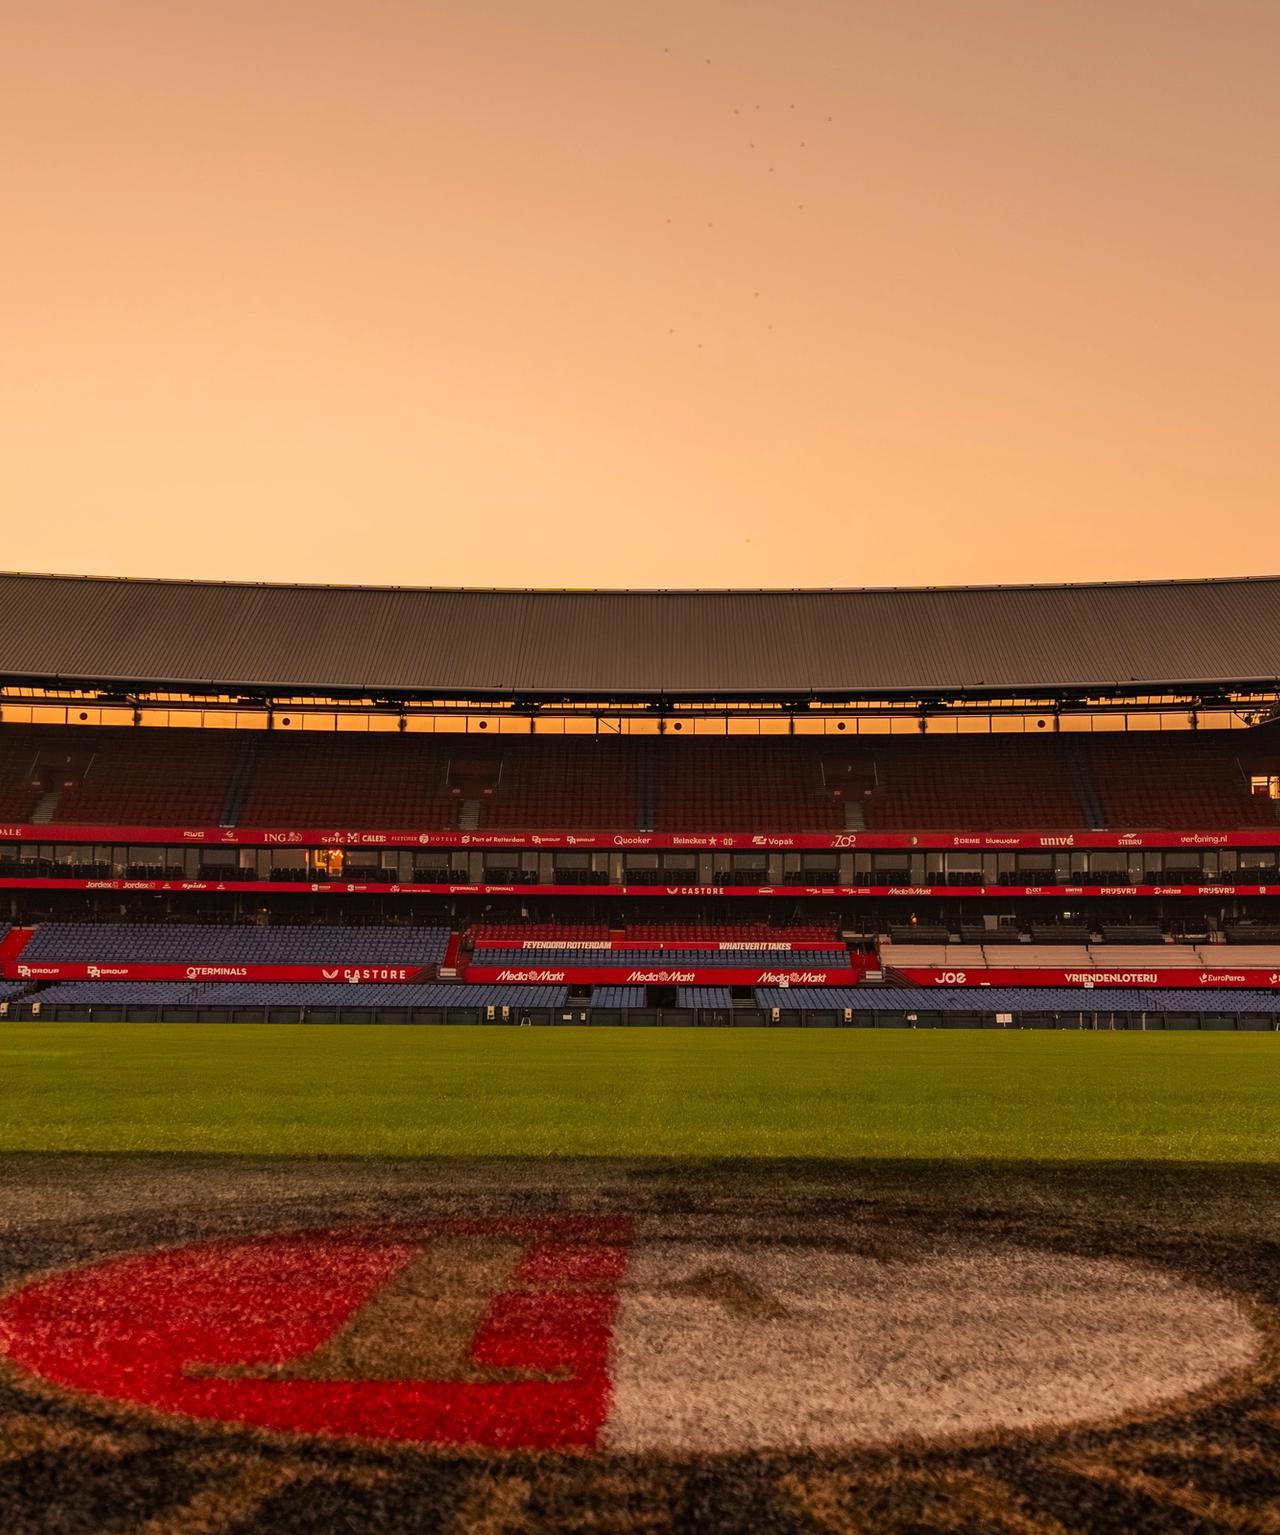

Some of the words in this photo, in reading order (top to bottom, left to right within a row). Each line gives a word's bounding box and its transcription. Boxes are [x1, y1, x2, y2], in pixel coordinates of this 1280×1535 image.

[264, 833, 286, 843] ING
[613, 835, 651, 845] Quooker
[673, 837, 707, 845] Heineken
[769, 838, 794, 846] Vopak
[1040, 835, 1074, 846] univé
[1181, 834, 1228, 845] verloning.nl
[86, 881, 114, 889] Jordex
[122, 881, 150, 889] Jordex
[681, 887, 725, 895] CASTORE
[522, 941, 566, 949] FEYENOORD
[567, 941, 612, 949] ROTTERDAM
[719, 942, 760, 950] WHATEVER
[761, 942, 768, 950] IT
[769, 942, 792, 950] TAKES
[344, 969, 407, 979] CASTORE
[1064, 973, 1158, 984] VRIENDENLOTERIJ
[1207, 974, 1245, 983] EuroParcs
